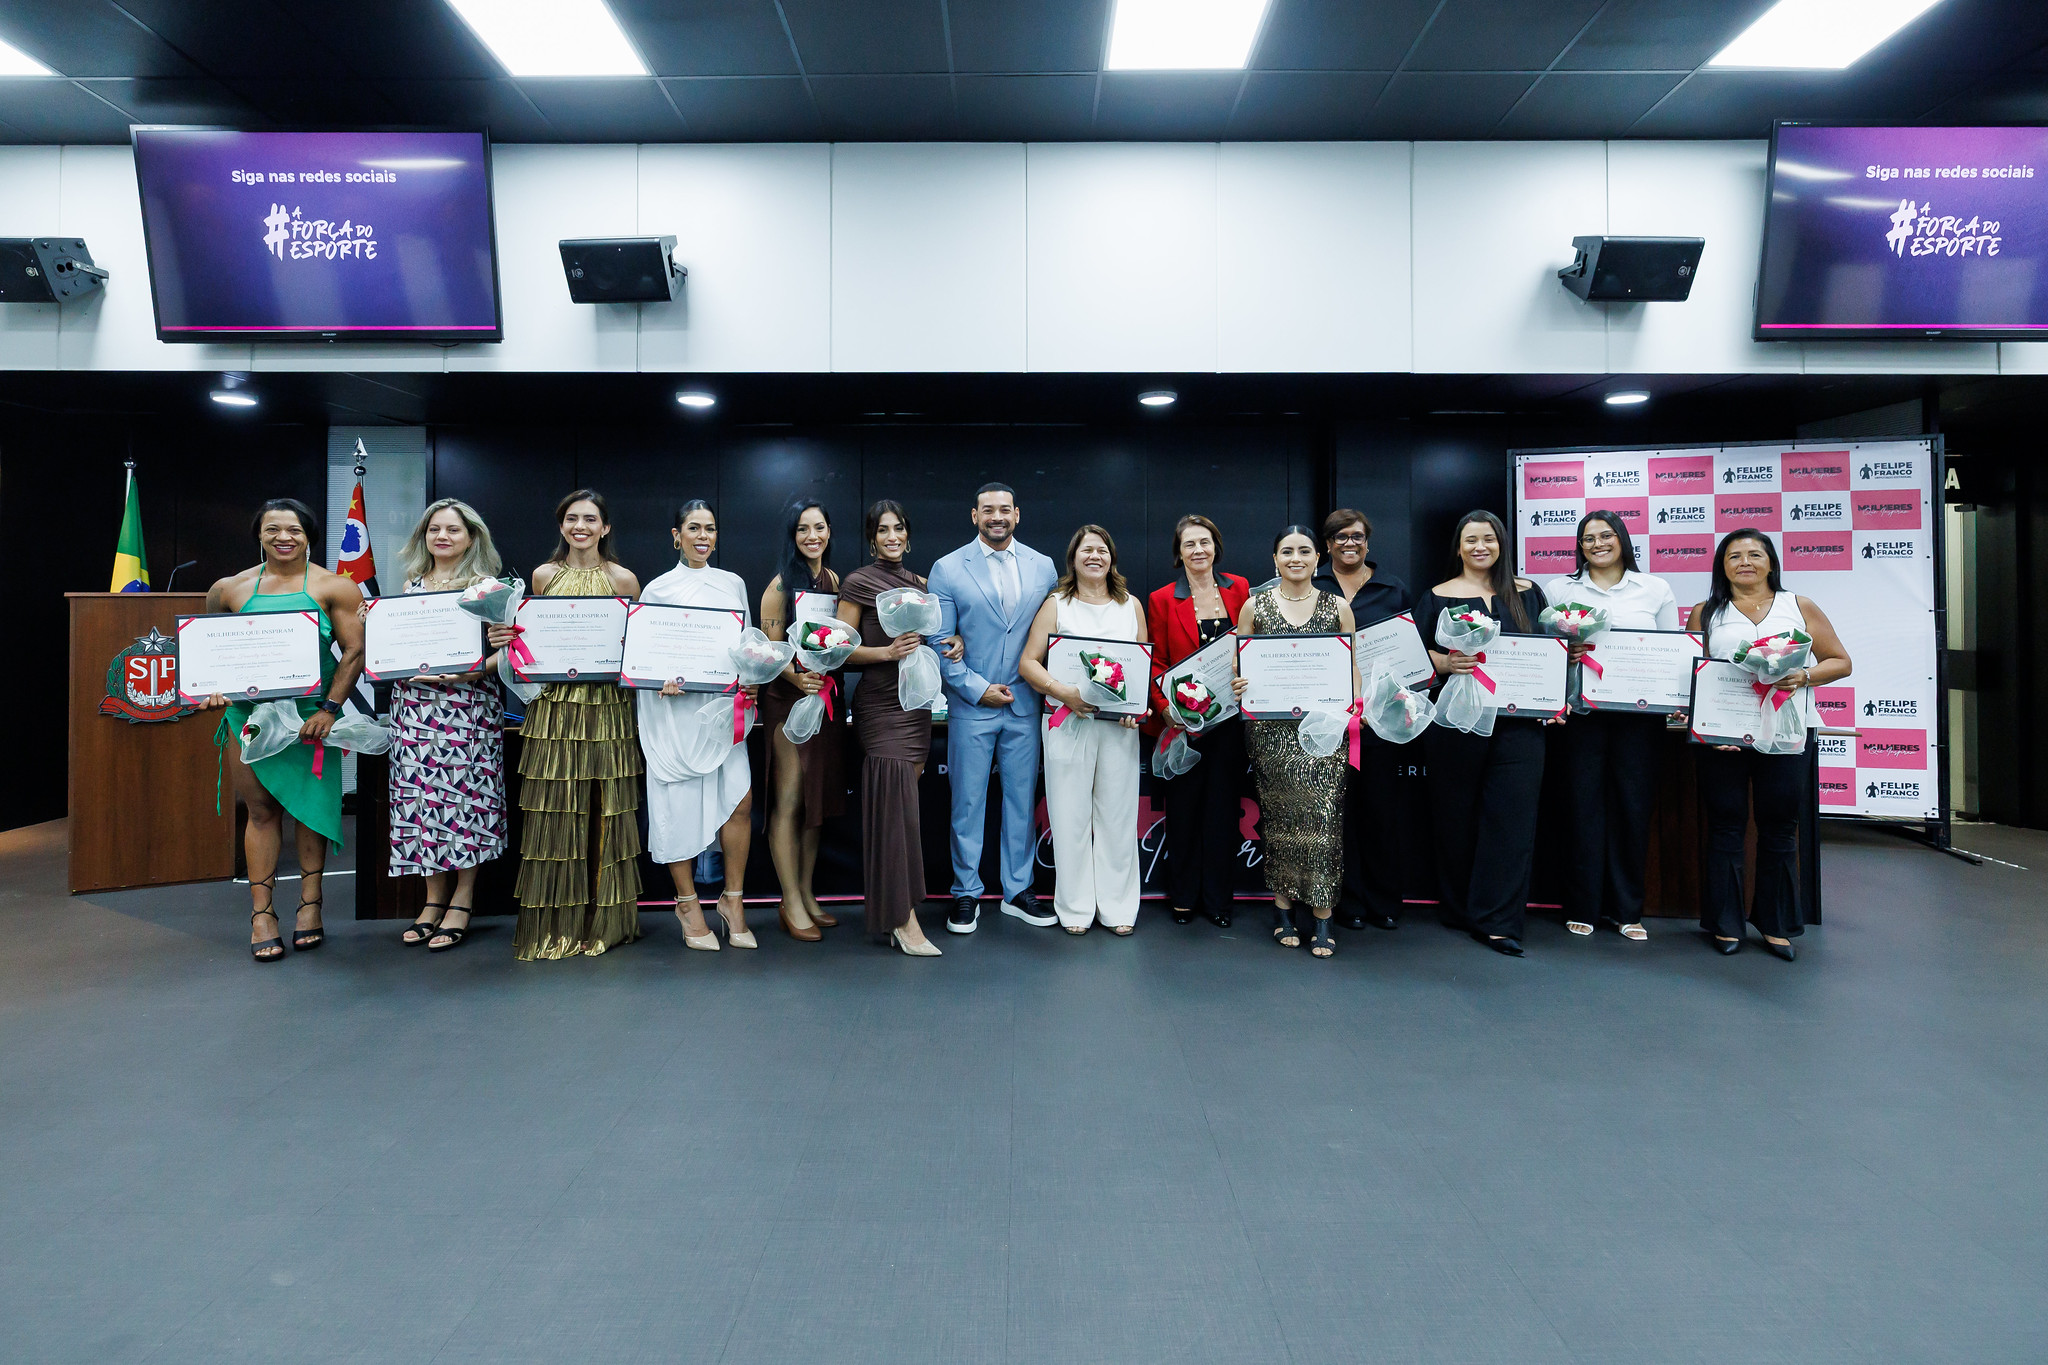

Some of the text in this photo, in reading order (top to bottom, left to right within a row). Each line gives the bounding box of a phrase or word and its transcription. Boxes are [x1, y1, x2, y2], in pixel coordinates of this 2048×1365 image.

[231, 169, 397, 186] Siga nas redes sociais
[1866, 165, 2034, 181] Siga nas redes sociais
[291, 220, 373, 240] FORÇA DO
[1916, 216, 2000, 237] FORÇA DO
[290, 239, 377, 260] ESPORTE
[1910, 236, 2002, 257] ESPORTE
[1605, 470, 1640, 478] FELIPE
[1655, 471, 1706, 479] MULHERES
[1804, 503, 1842, 511] FELIPE
[207, 630, 244, 638] MULHERES
[262, 627, 294, 635] INSPIRAM
[1363, 632, 1398, 649] QUE INSPIRAM
[1863, 743, 1920, 751] MULHERES
[1880, 782, 1919, 790] FELIPE
